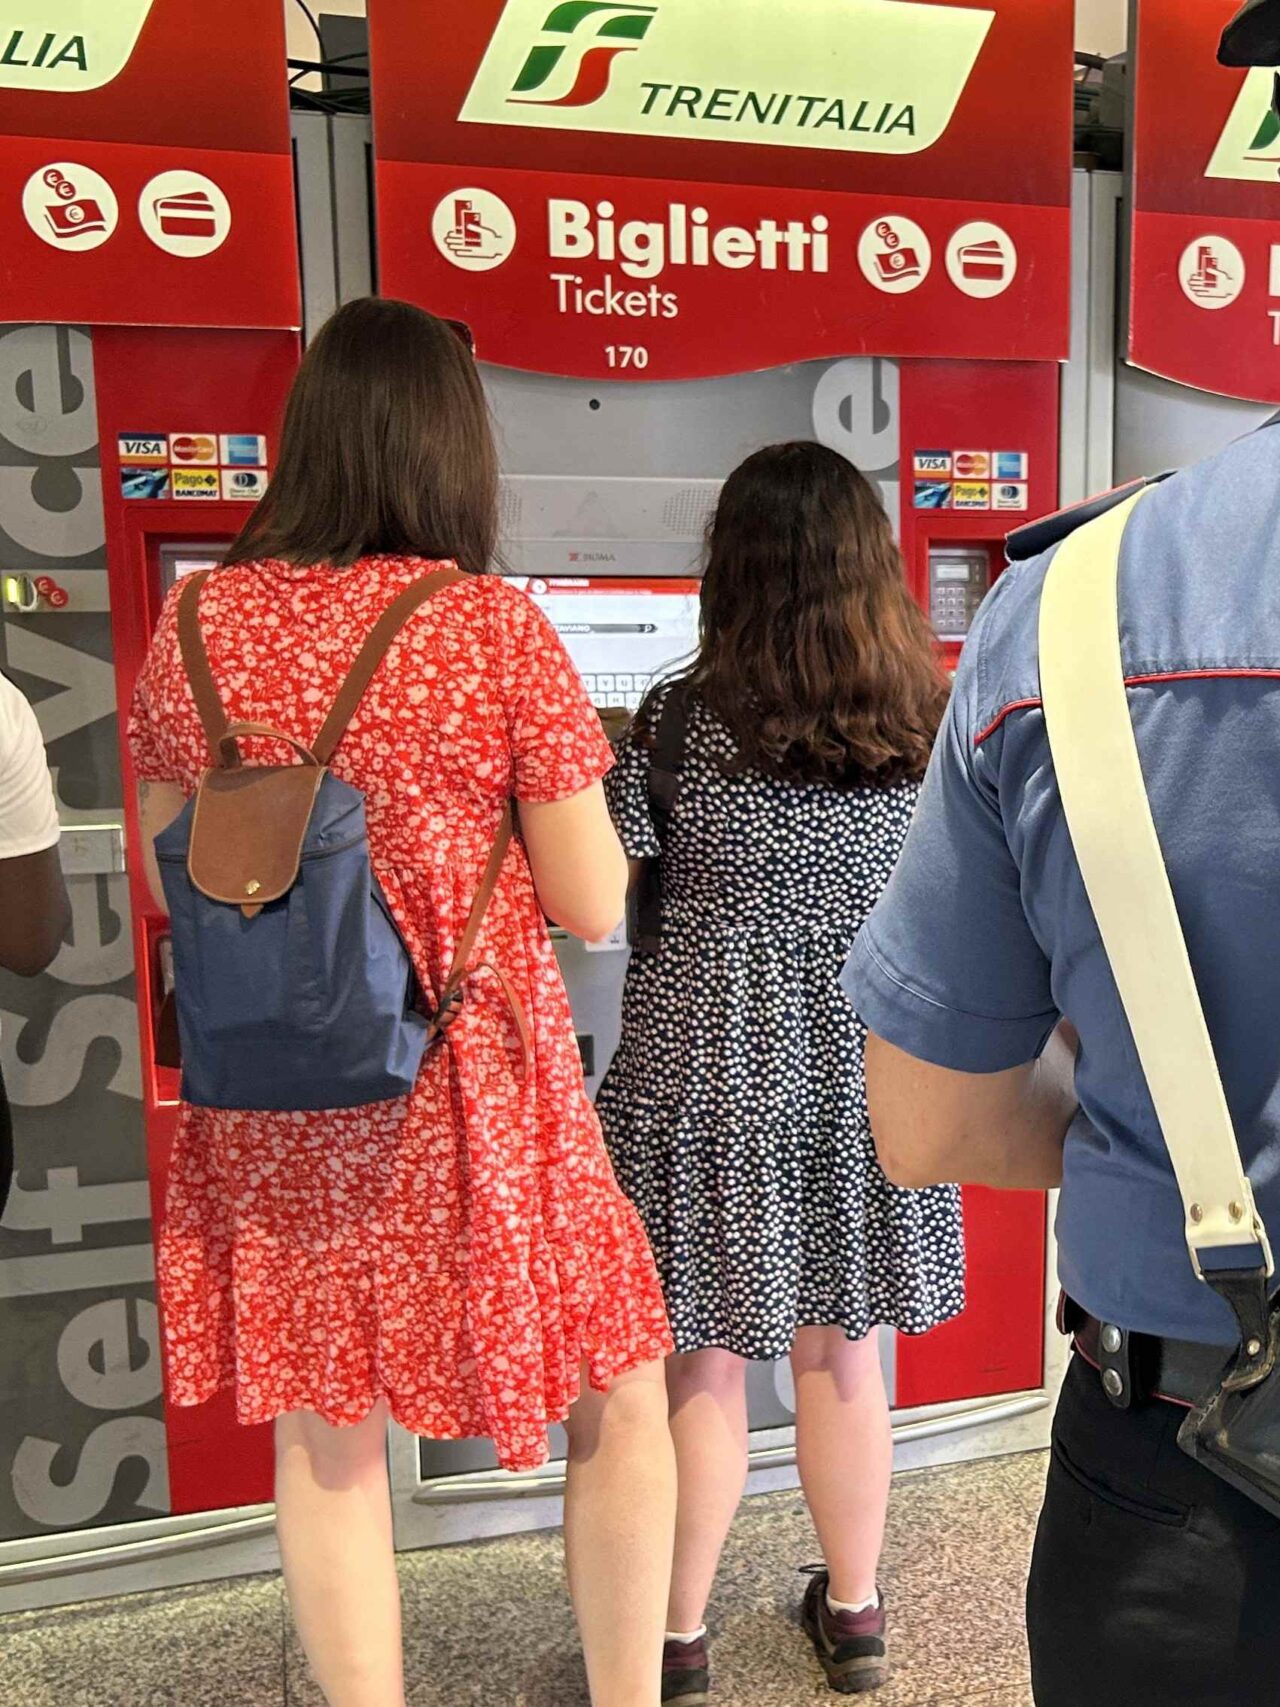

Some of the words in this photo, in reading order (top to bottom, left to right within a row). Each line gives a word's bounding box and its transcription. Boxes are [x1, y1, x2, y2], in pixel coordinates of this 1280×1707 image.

[640, 82, 915, 136] TRENITALIA
[548, 198, 829, 279] Biglietti
[550, 273, 678, 318] Tickets
[604, 346, 648, 368] 170
[125, 441, 161, 454] VISA
[918, 458, 947, 469] VISA
